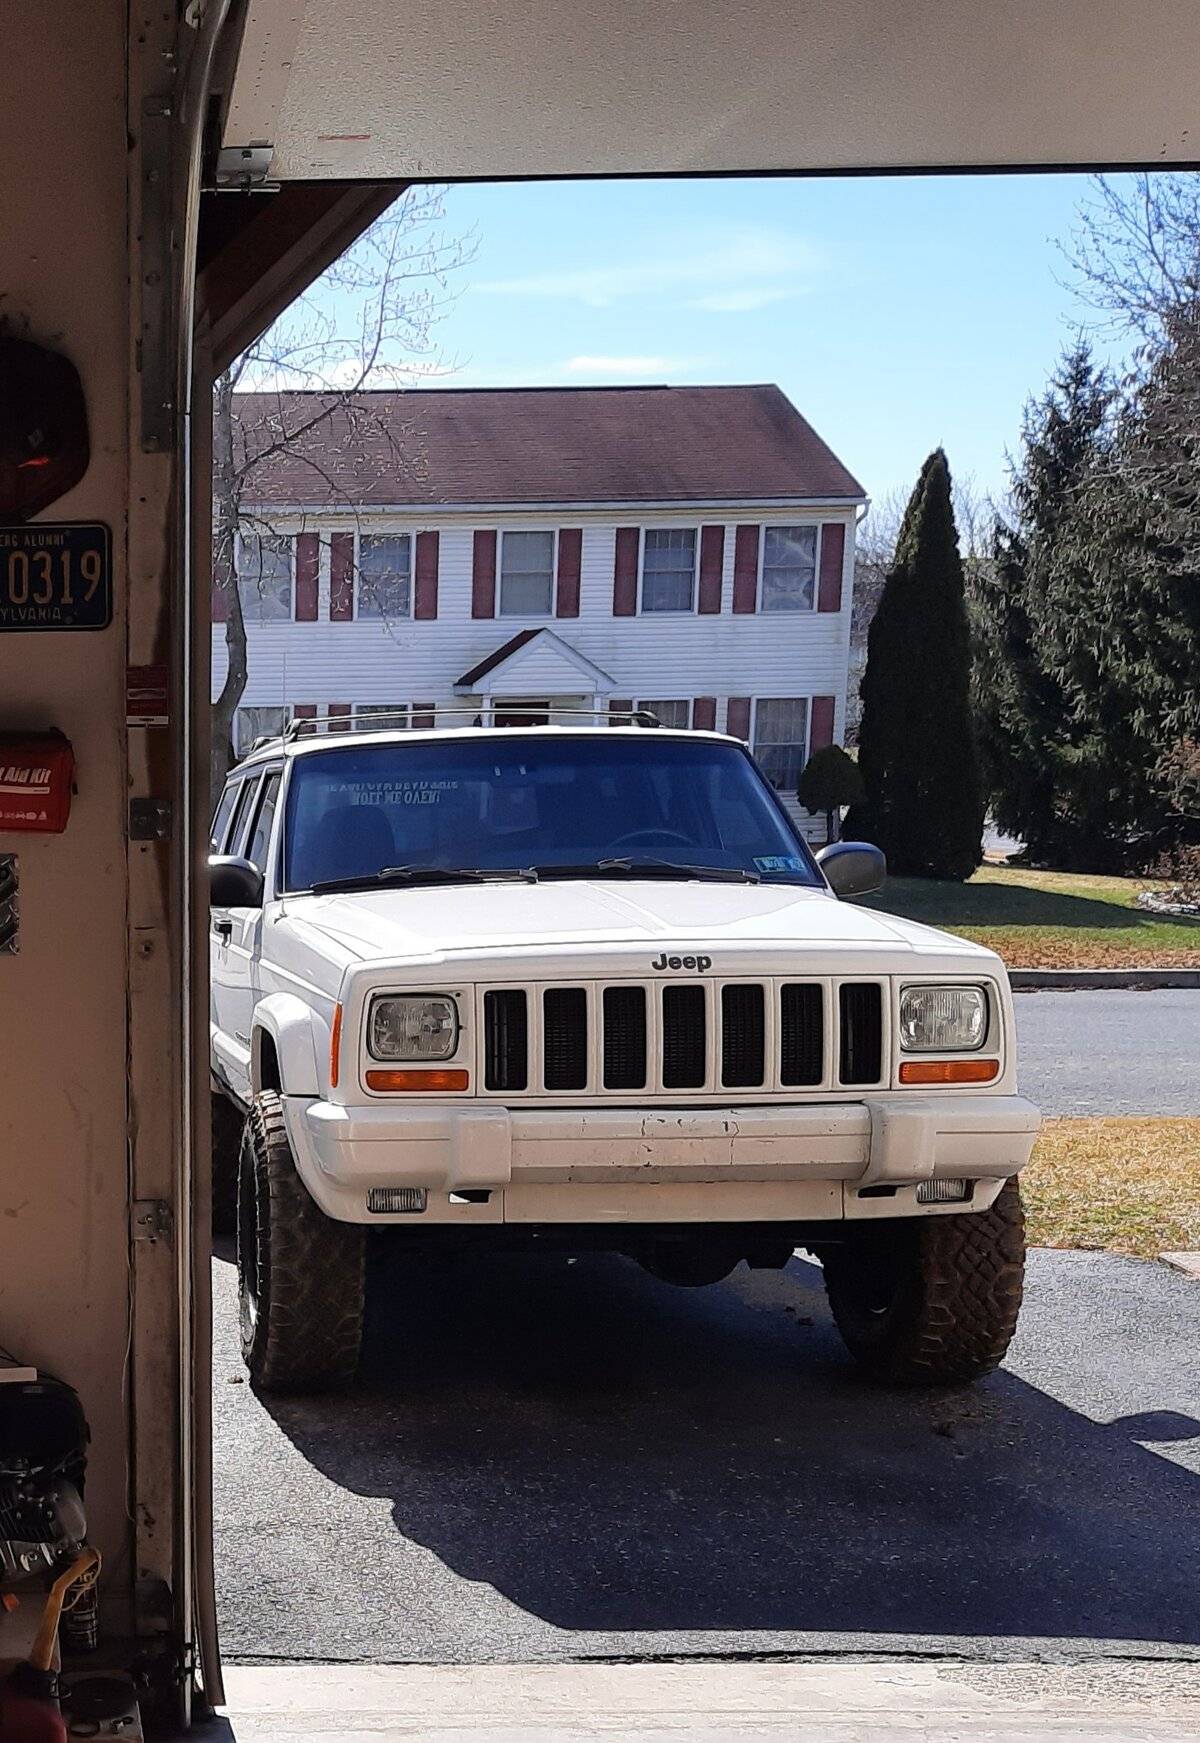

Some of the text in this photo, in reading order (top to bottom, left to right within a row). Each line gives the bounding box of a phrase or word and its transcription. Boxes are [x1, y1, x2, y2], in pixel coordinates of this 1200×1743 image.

[24, 534, 64, 547] ALUMNI
[3, 766, 31, 783] Aid
[29, 768, 52, 784] Kit
[651, 953, 712, 973] Jeep
